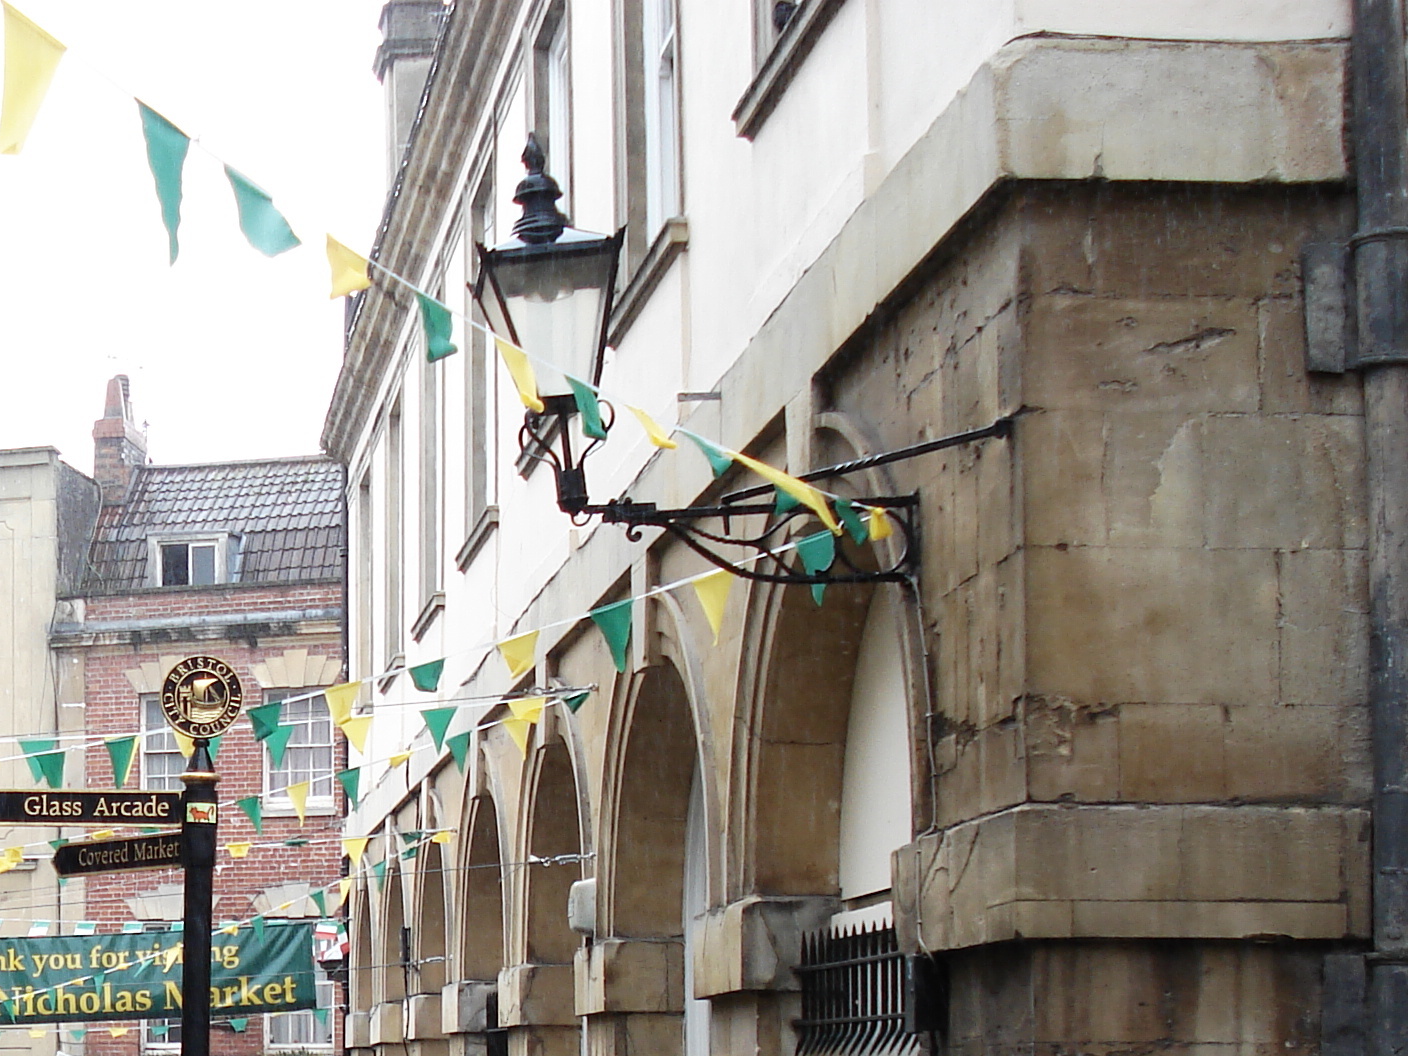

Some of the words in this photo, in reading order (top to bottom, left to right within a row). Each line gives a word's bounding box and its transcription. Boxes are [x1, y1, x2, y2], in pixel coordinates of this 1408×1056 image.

[169, 657, 234, 684] BRISTOL
[164, 693, 186, 724] CITY
[189, 693, 241, 735] COUNCIL
[24, 794, 83, 817] Glass
[93, 795, 169, 817] Arcade
[78, 841, 130, 867] Covered
[133, 838, 180, 863] Market
[32, 954, 83, 978] you
[90, 945, 130, 969] for
